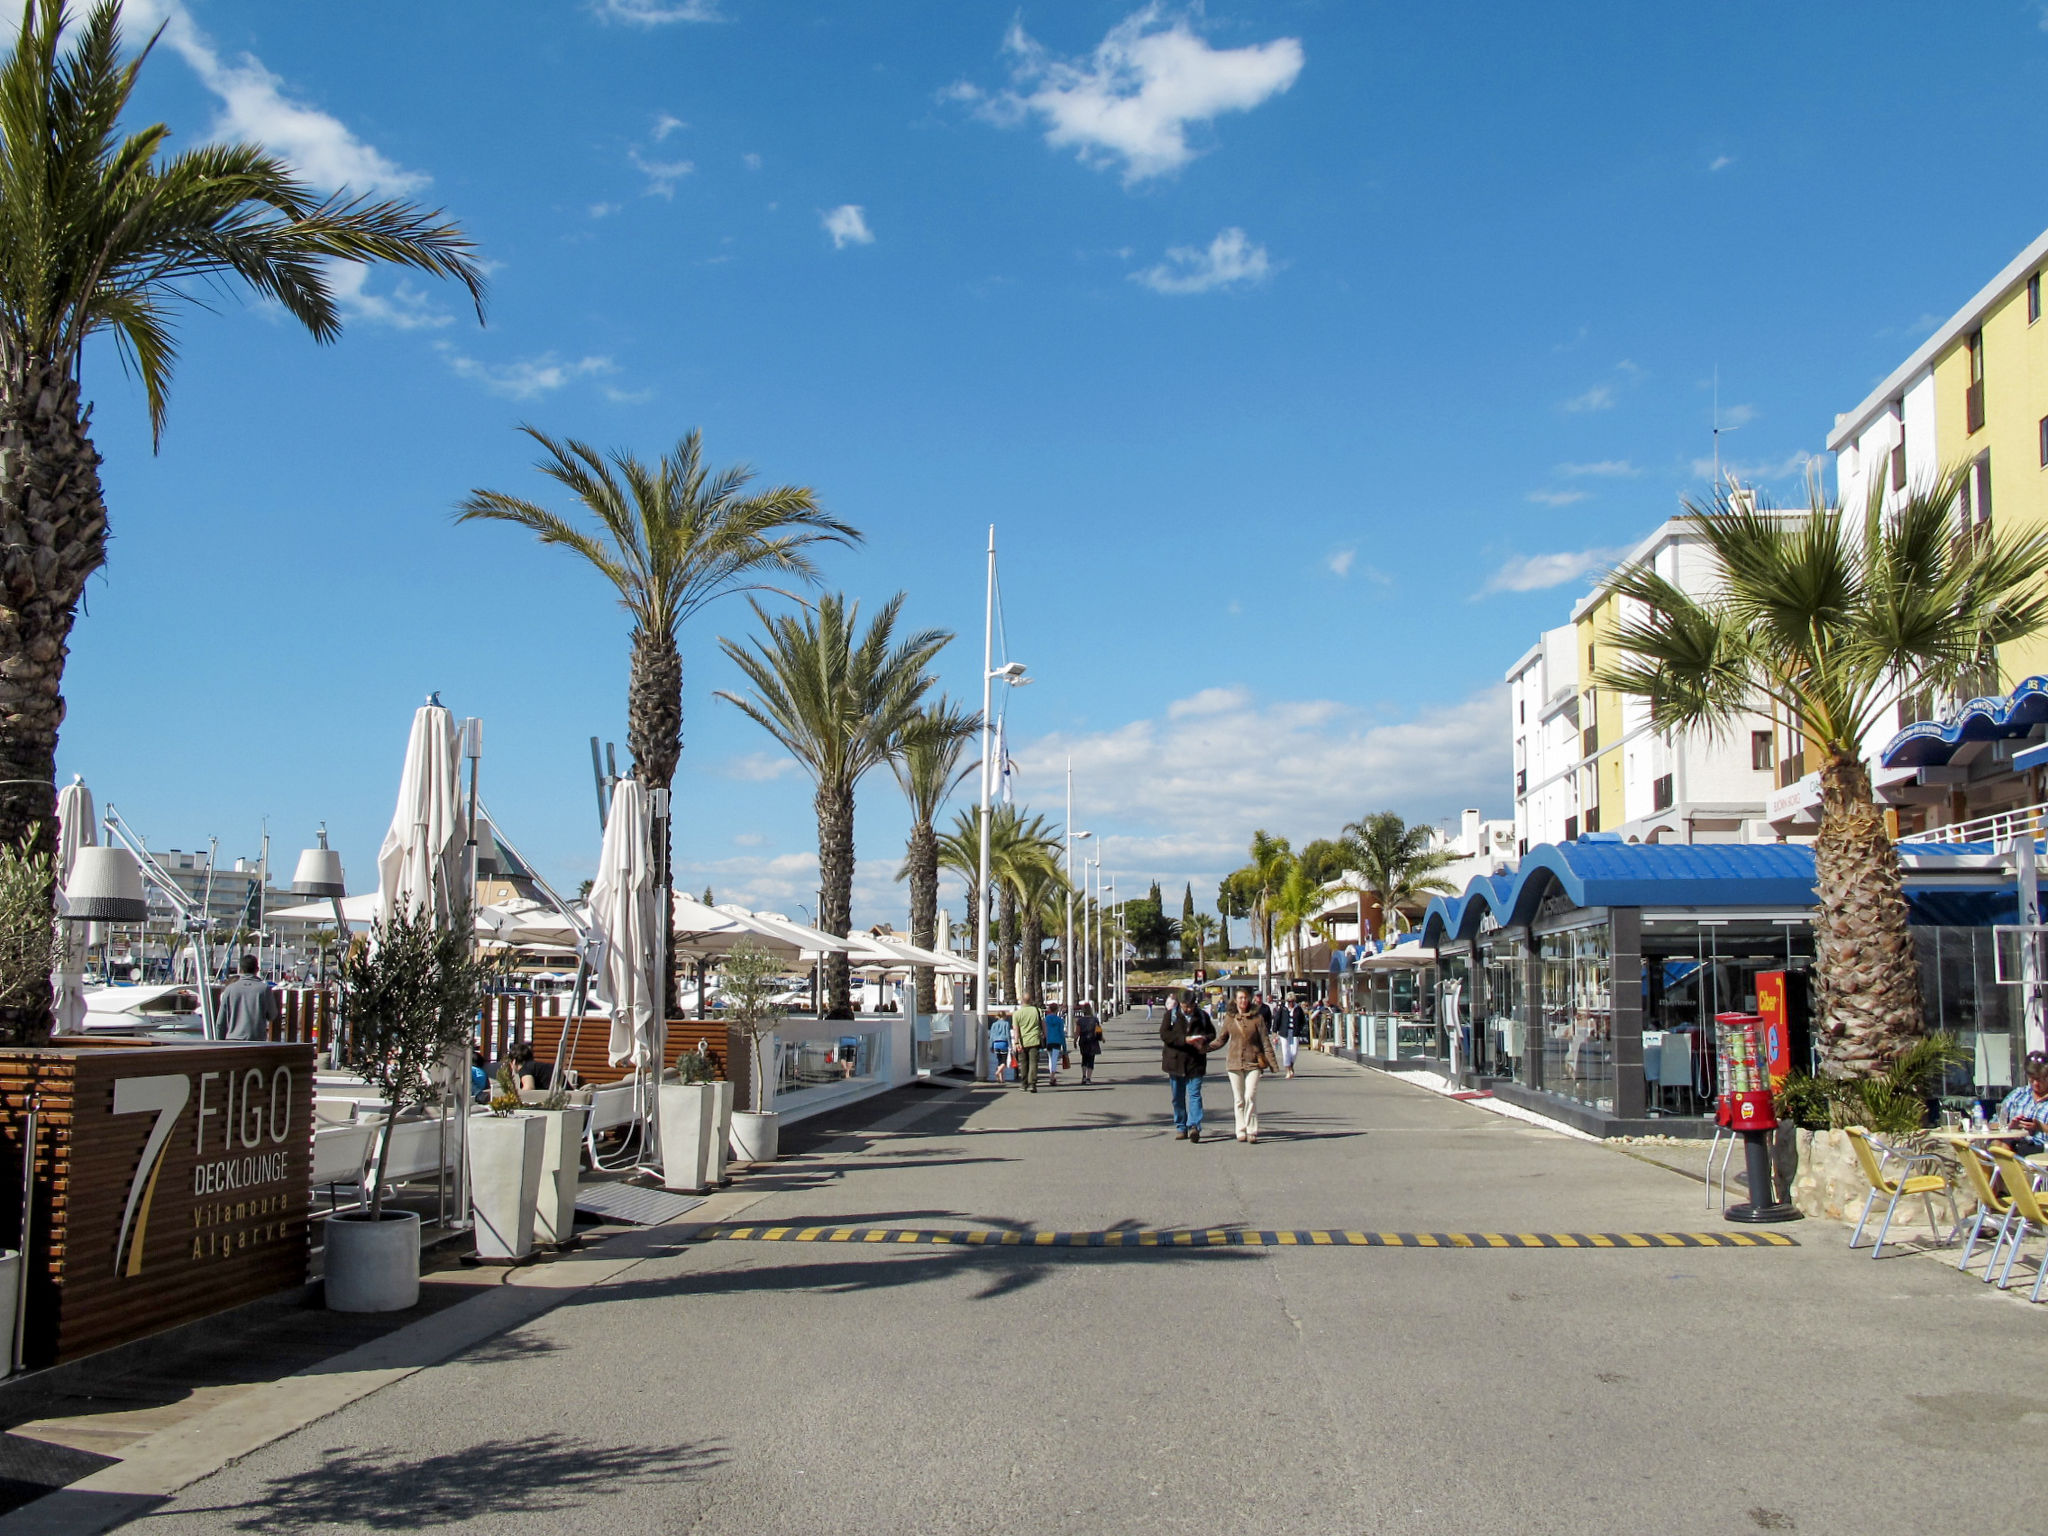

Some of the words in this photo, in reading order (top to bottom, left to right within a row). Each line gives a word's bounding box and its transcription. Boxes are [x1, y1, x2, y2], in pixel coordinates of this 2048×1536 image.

[197, 1065, 292, 1155] FIGO
[194, 1151, 289, 1196] DECKLOUNGE
[194, 1193, 288, 1229] Vilamoura
[193, 1221, 287, 1260] Algarve
